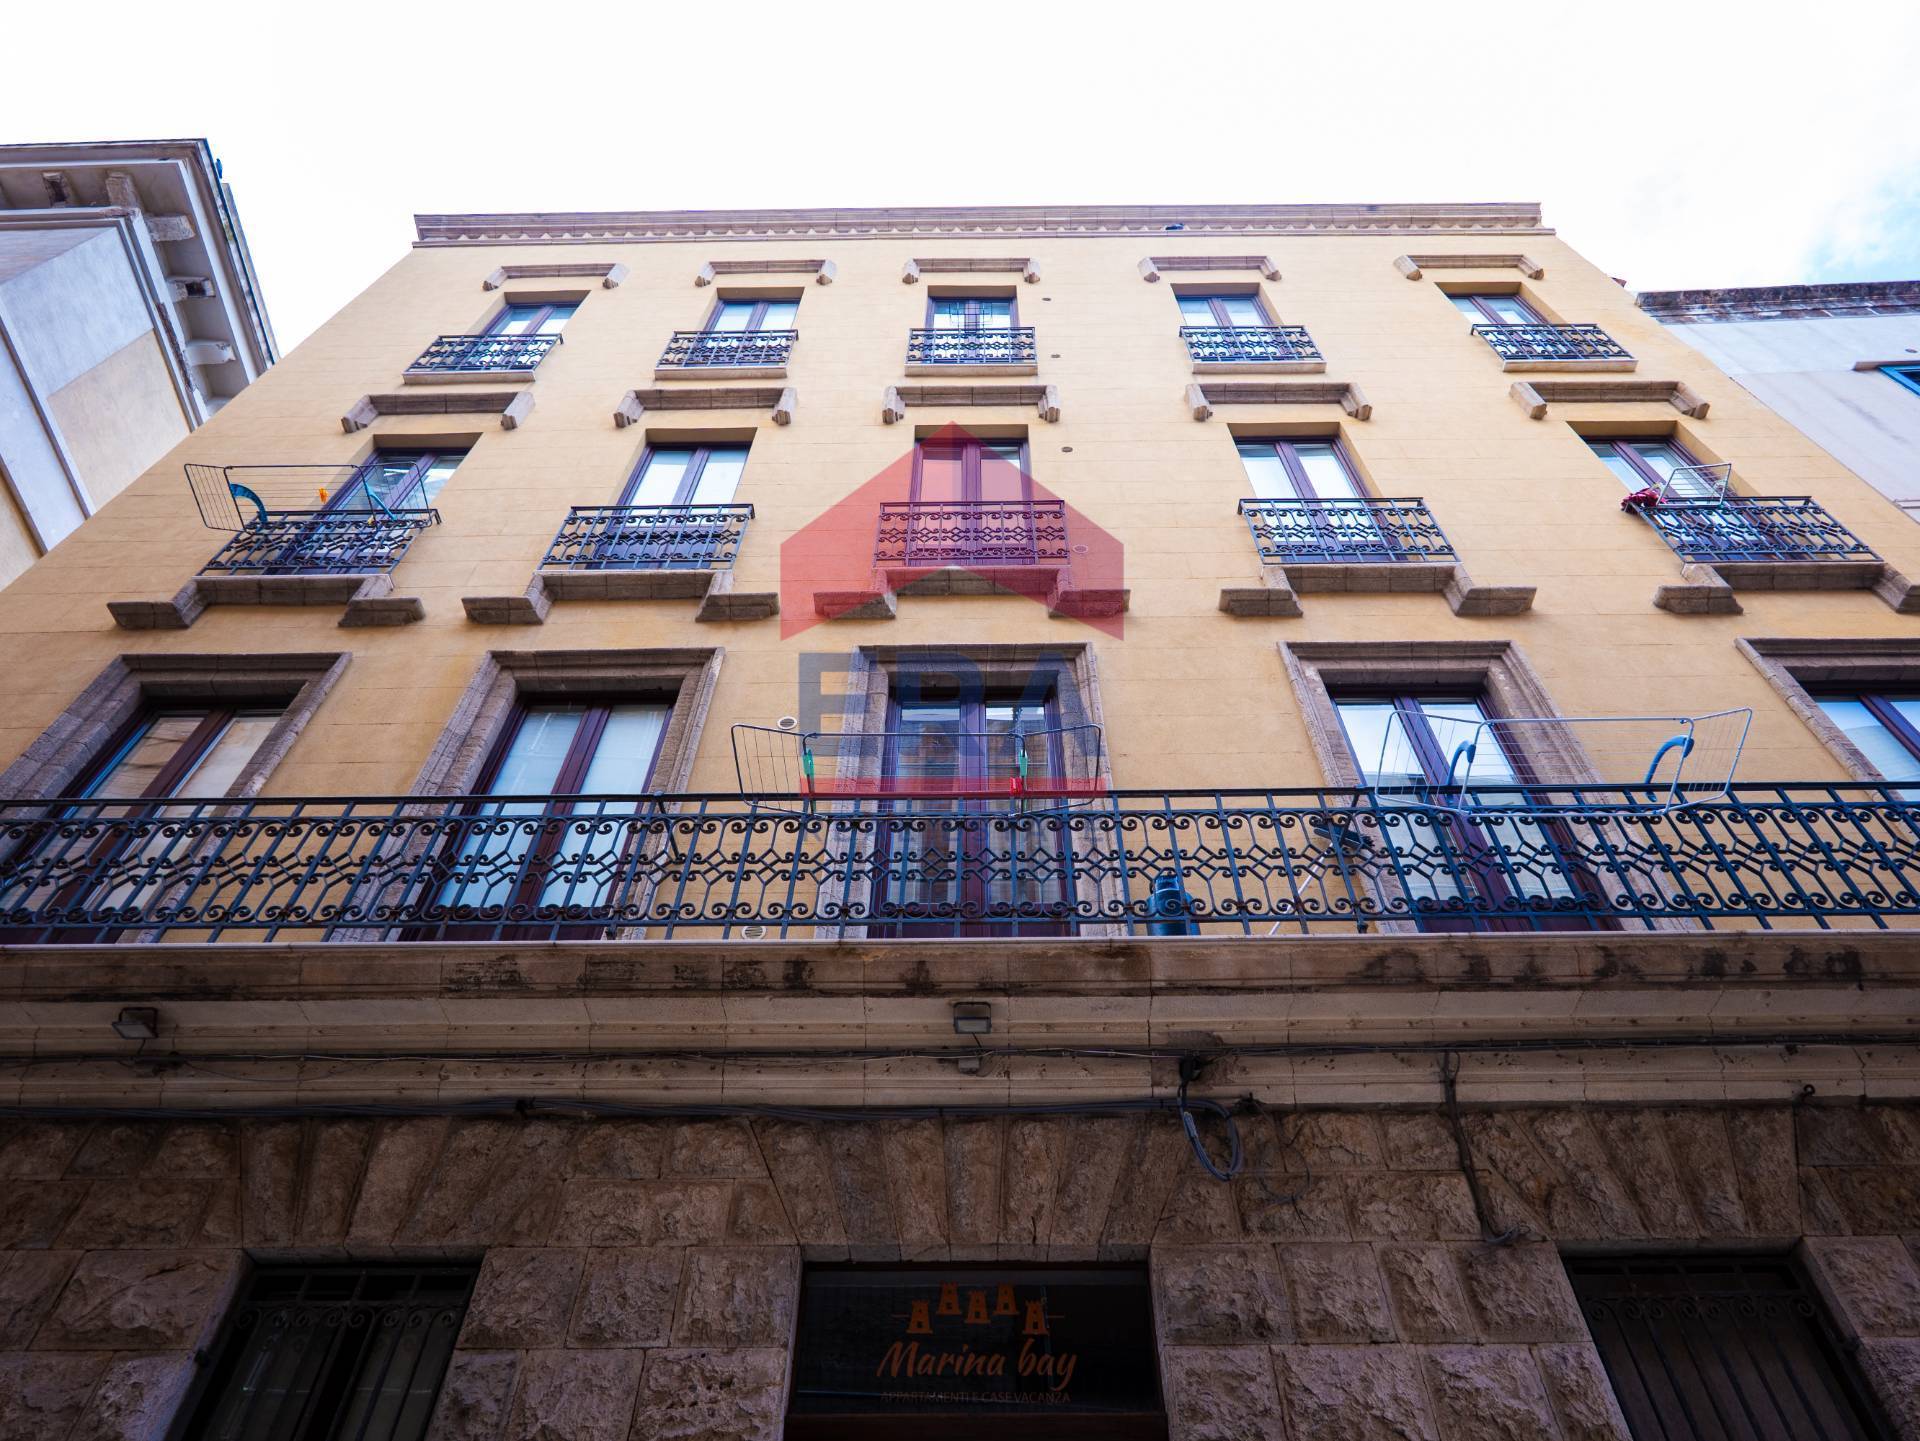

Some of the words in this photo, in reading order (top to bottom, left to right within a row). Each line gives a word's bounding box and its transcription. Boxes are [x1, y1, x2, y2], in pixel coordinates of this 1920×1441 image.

[876, 1341, 1007, 1377] Marina
[1017, 1337, 1078, 1391] bay
[982, 1391, 1012, 1402] CASE
[1014, 1391, 1072, 1403] VACANZA
